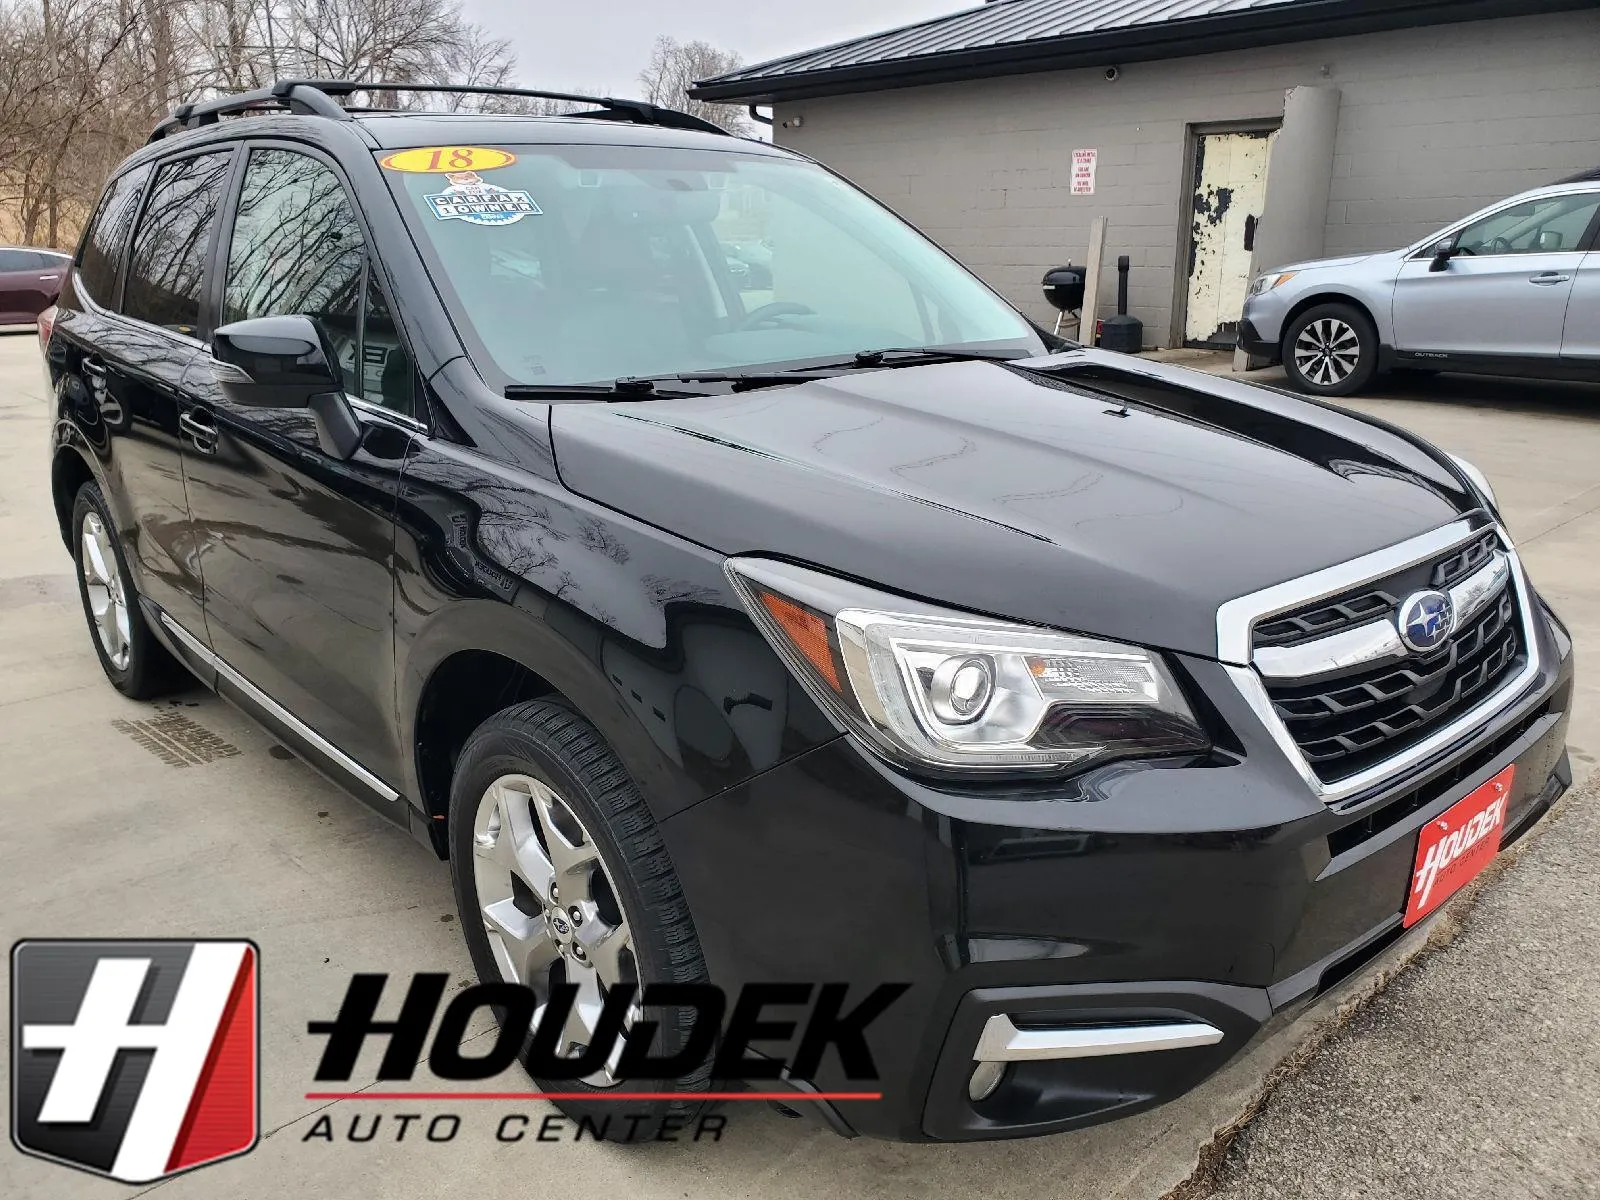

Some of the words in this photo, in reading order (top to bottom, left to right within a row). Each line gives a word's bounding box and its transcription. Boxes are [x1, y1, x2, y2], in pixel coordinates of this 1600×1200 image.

[426, 149, 473, 170] 18
[436, 194, 528, 205] CARFAX
[1415, 790, 1509, 911] HOUDEK
[1432, 863, 1457, 888] AUTO
[1460, 836, 1490, 867] CENTER
